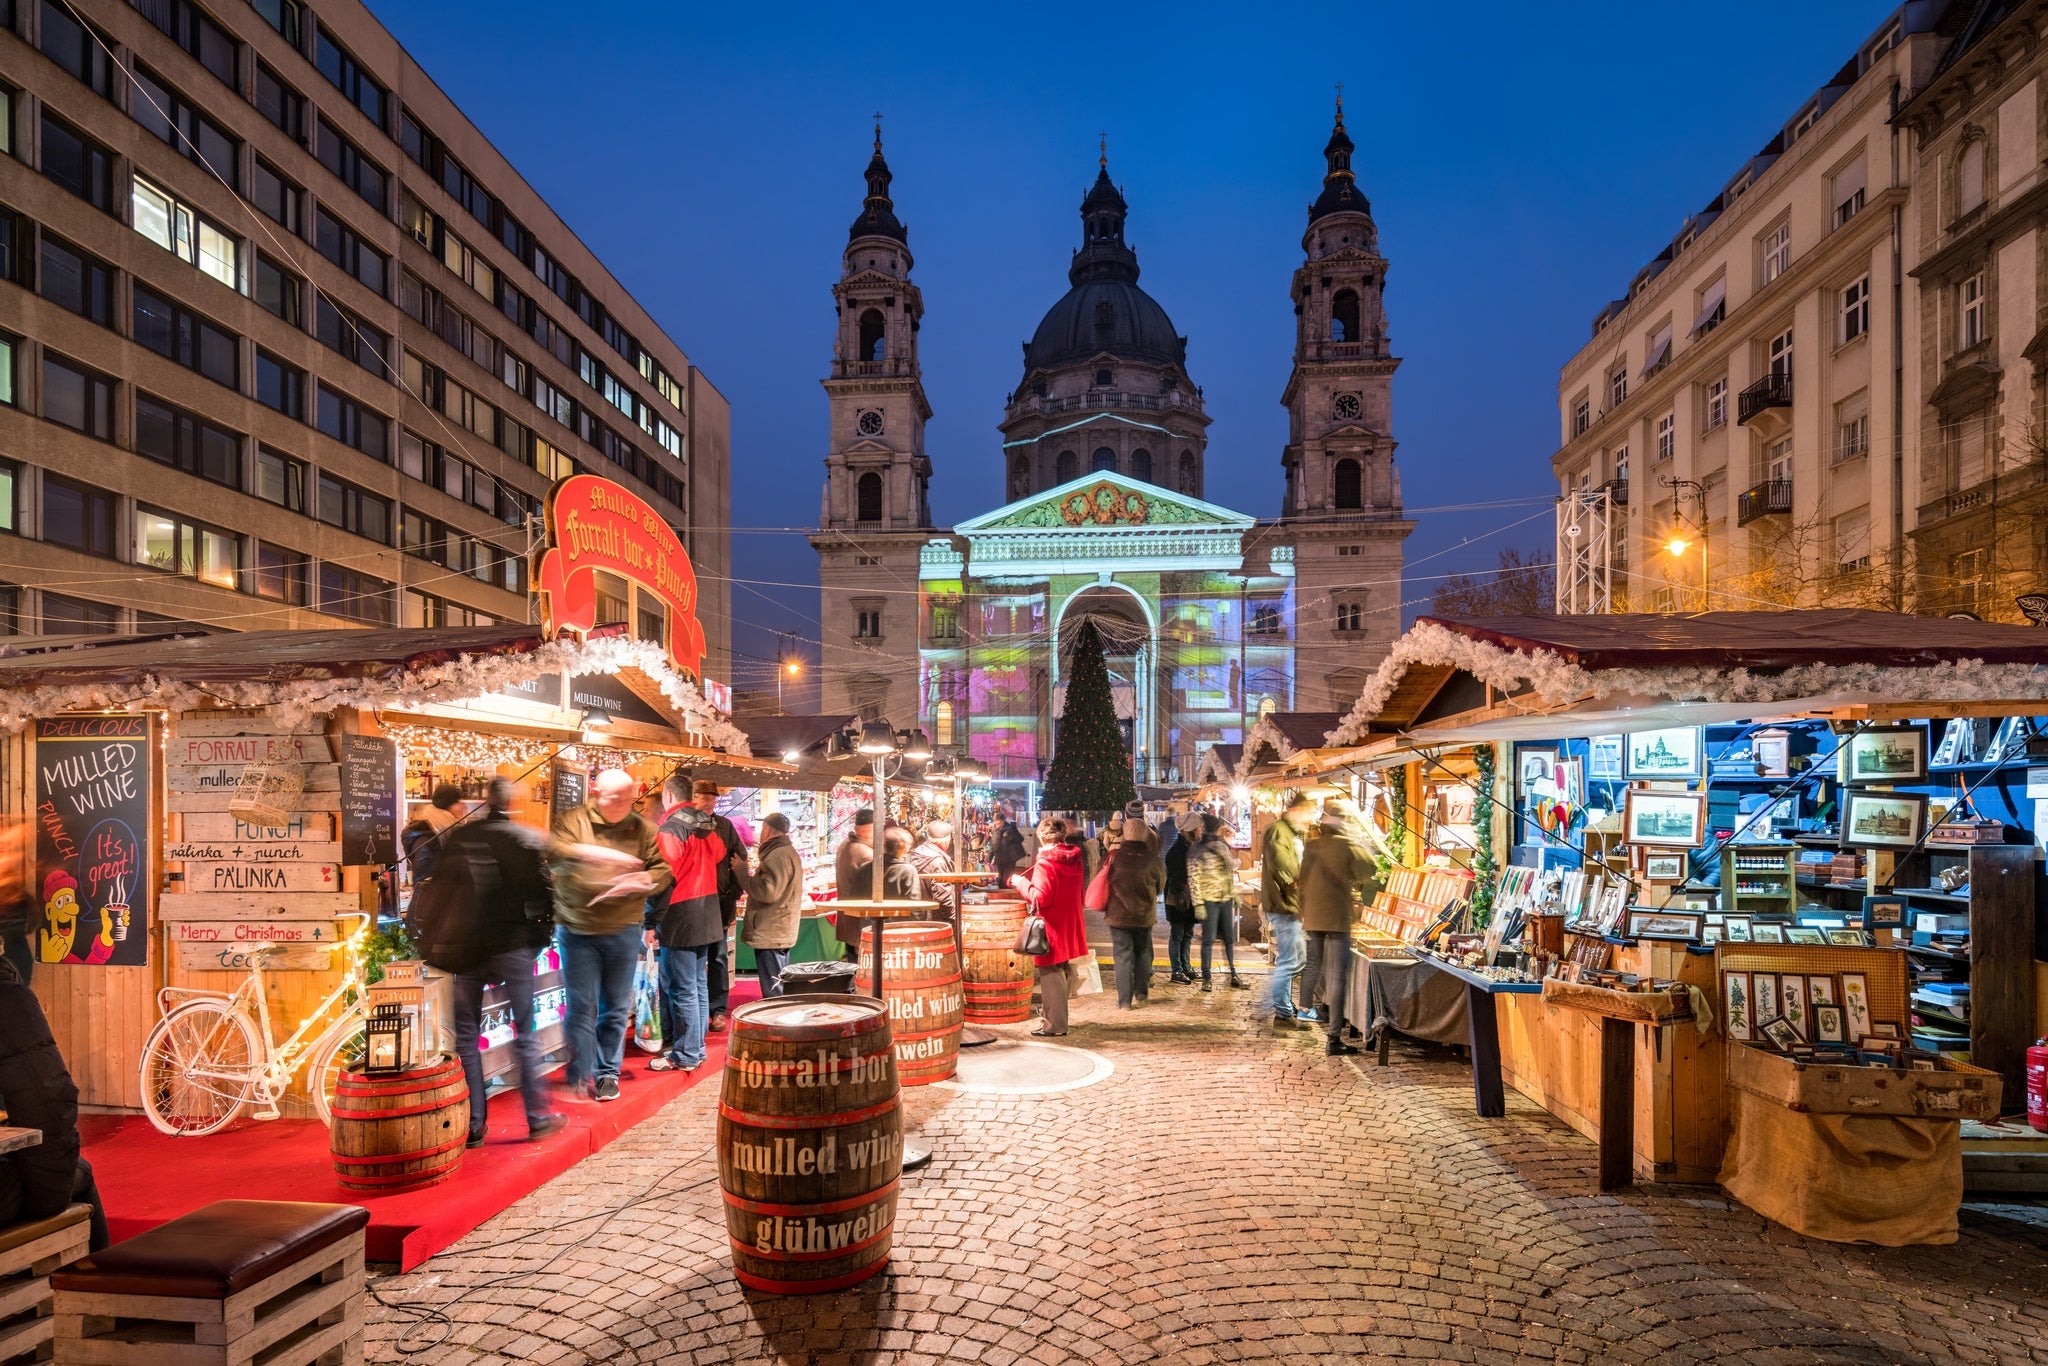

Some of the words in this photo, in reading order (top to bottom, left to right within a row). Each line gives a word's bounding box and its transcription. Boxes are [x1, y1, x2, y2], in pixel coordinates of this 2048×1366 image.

[590, 486, 637, 523] Mulled
[643, 511, 674, 555] Wine
[566, 509, 620, 561] Forralt
[623, 528, 644, 569] bor
[655, 548, 691, 613] Punch
[573, 692, 602, 707] MULLED
[604, 697, 622, 711] WINE
[42, 719, 143, 736] DELICIOUS
[43, 743, 136, 795] MULLED
[188, 741, 257, 762] FORRALT
[70, 770, 136, 815] WINE
[37, 800, 80, 861] PUNCH
[171, 841, 224, 859] pálinka
[254, 845, 303, 860] punch
[89, 843, 134, 897] great!
[214, 866, 287, 889] PÁLINKA
[181, 925, 221, 941] Merry
[234, 924, 302, 940] Christmas
[914, 947, 943, 970] bor
[888, 997, 925, 1020] lled
[929, 992, 961, 1016] wine
[739, 1049, 840, 1089] forralt
[850, 1048, 889, 1085] bor
[733, 1136, 836, 1176] mulled
[848, 1129, 899, 1170] wine
[756, 1201, 889, 1254] glühwein
